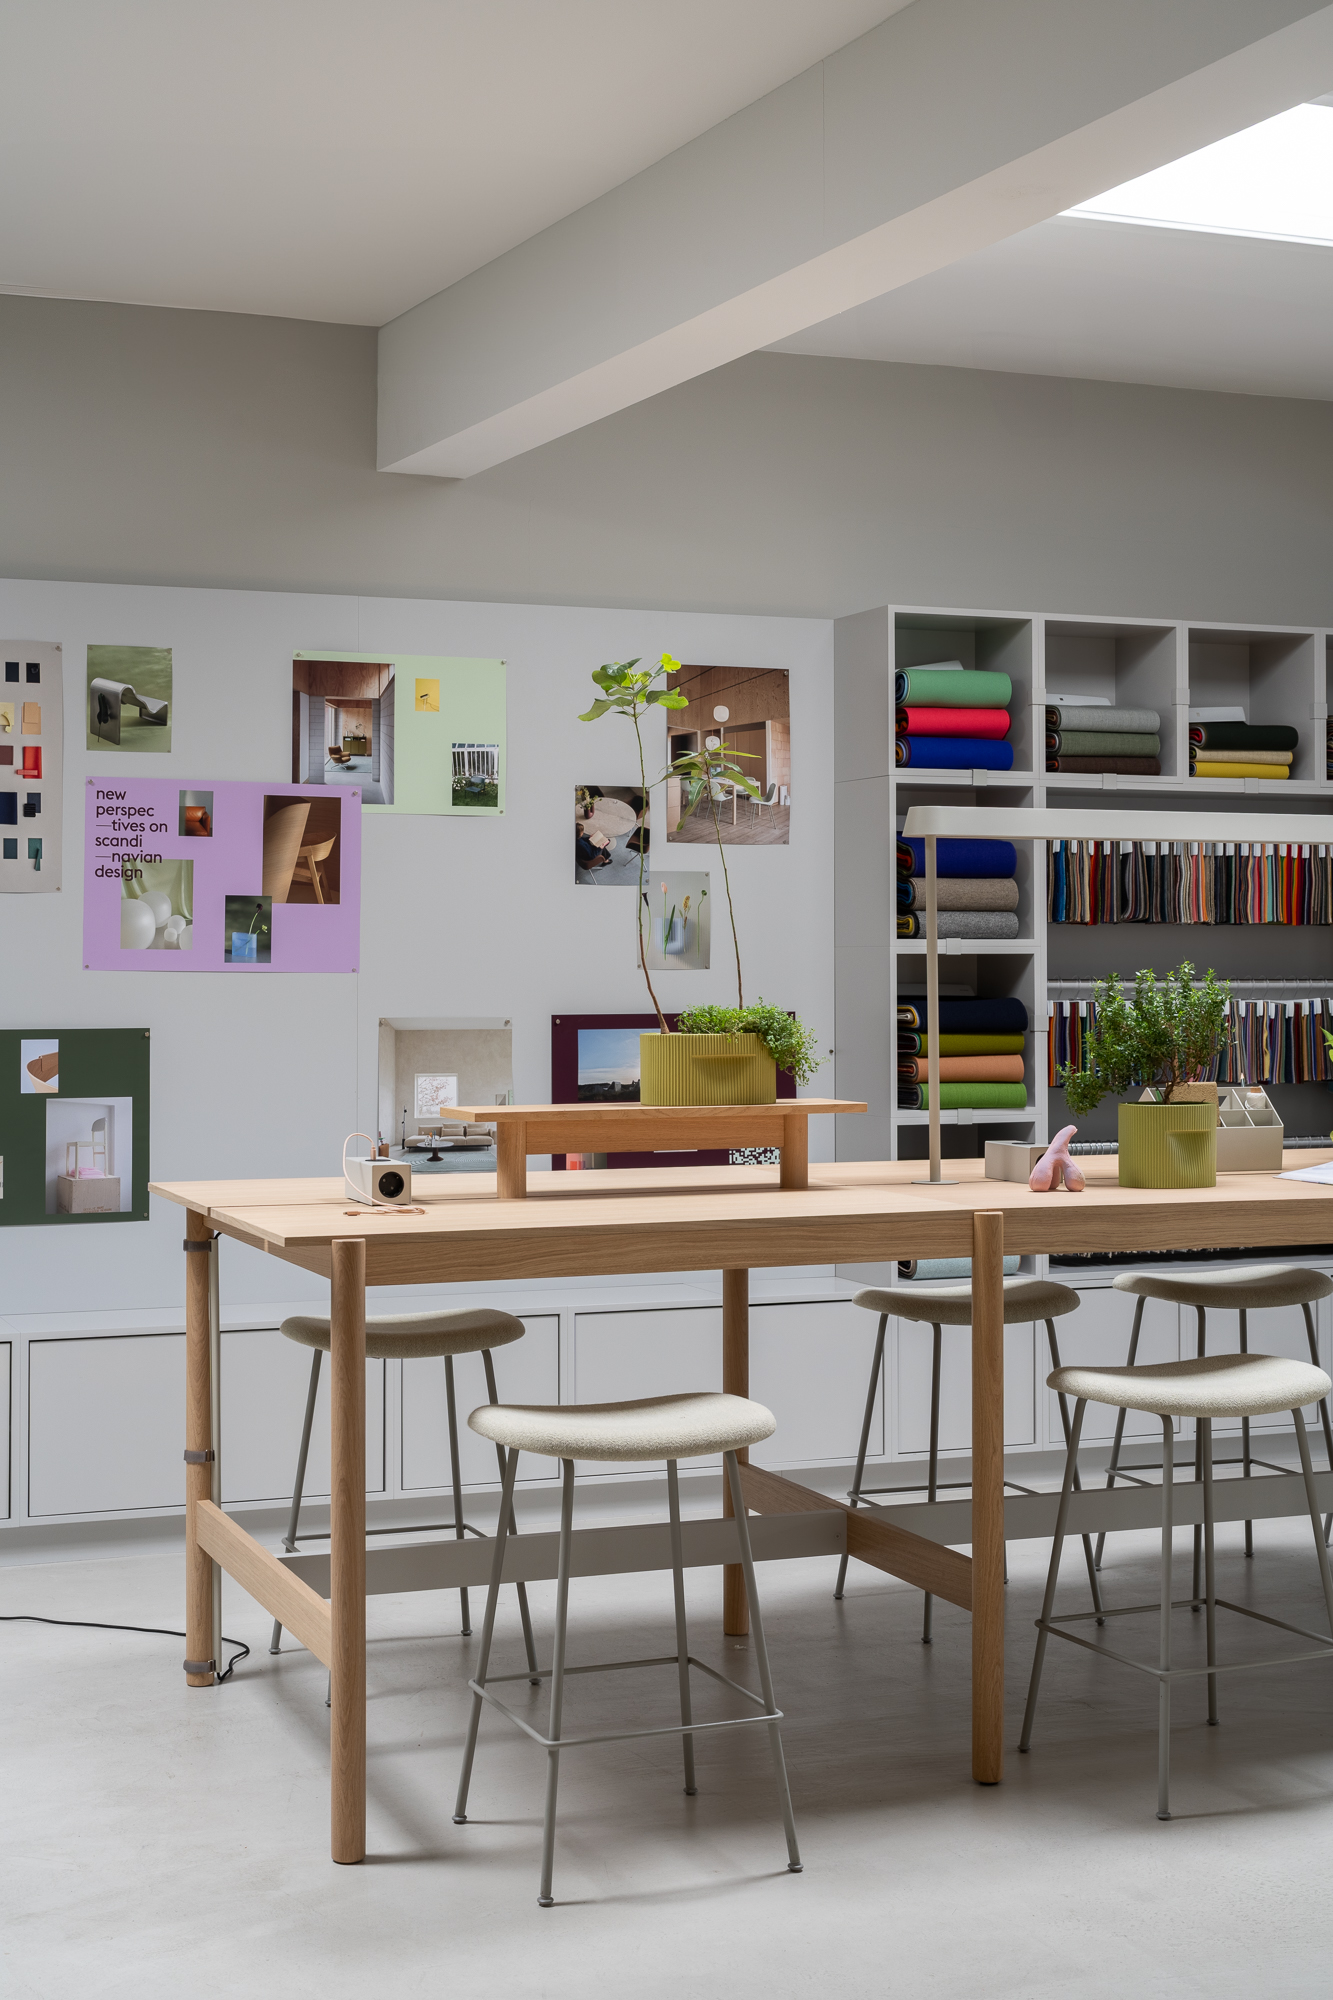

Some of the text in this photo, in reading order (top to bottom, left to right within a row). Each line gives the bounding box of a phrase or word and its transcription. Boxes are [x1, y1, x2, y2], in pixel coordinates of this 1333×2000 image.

[96, 789, 127, 800] new
[96, 805, 155, 819] perspec
[149, 822, 168, 833] on
[95, 834, 143, 848] scandi
[94, 865, 143, 881] design
